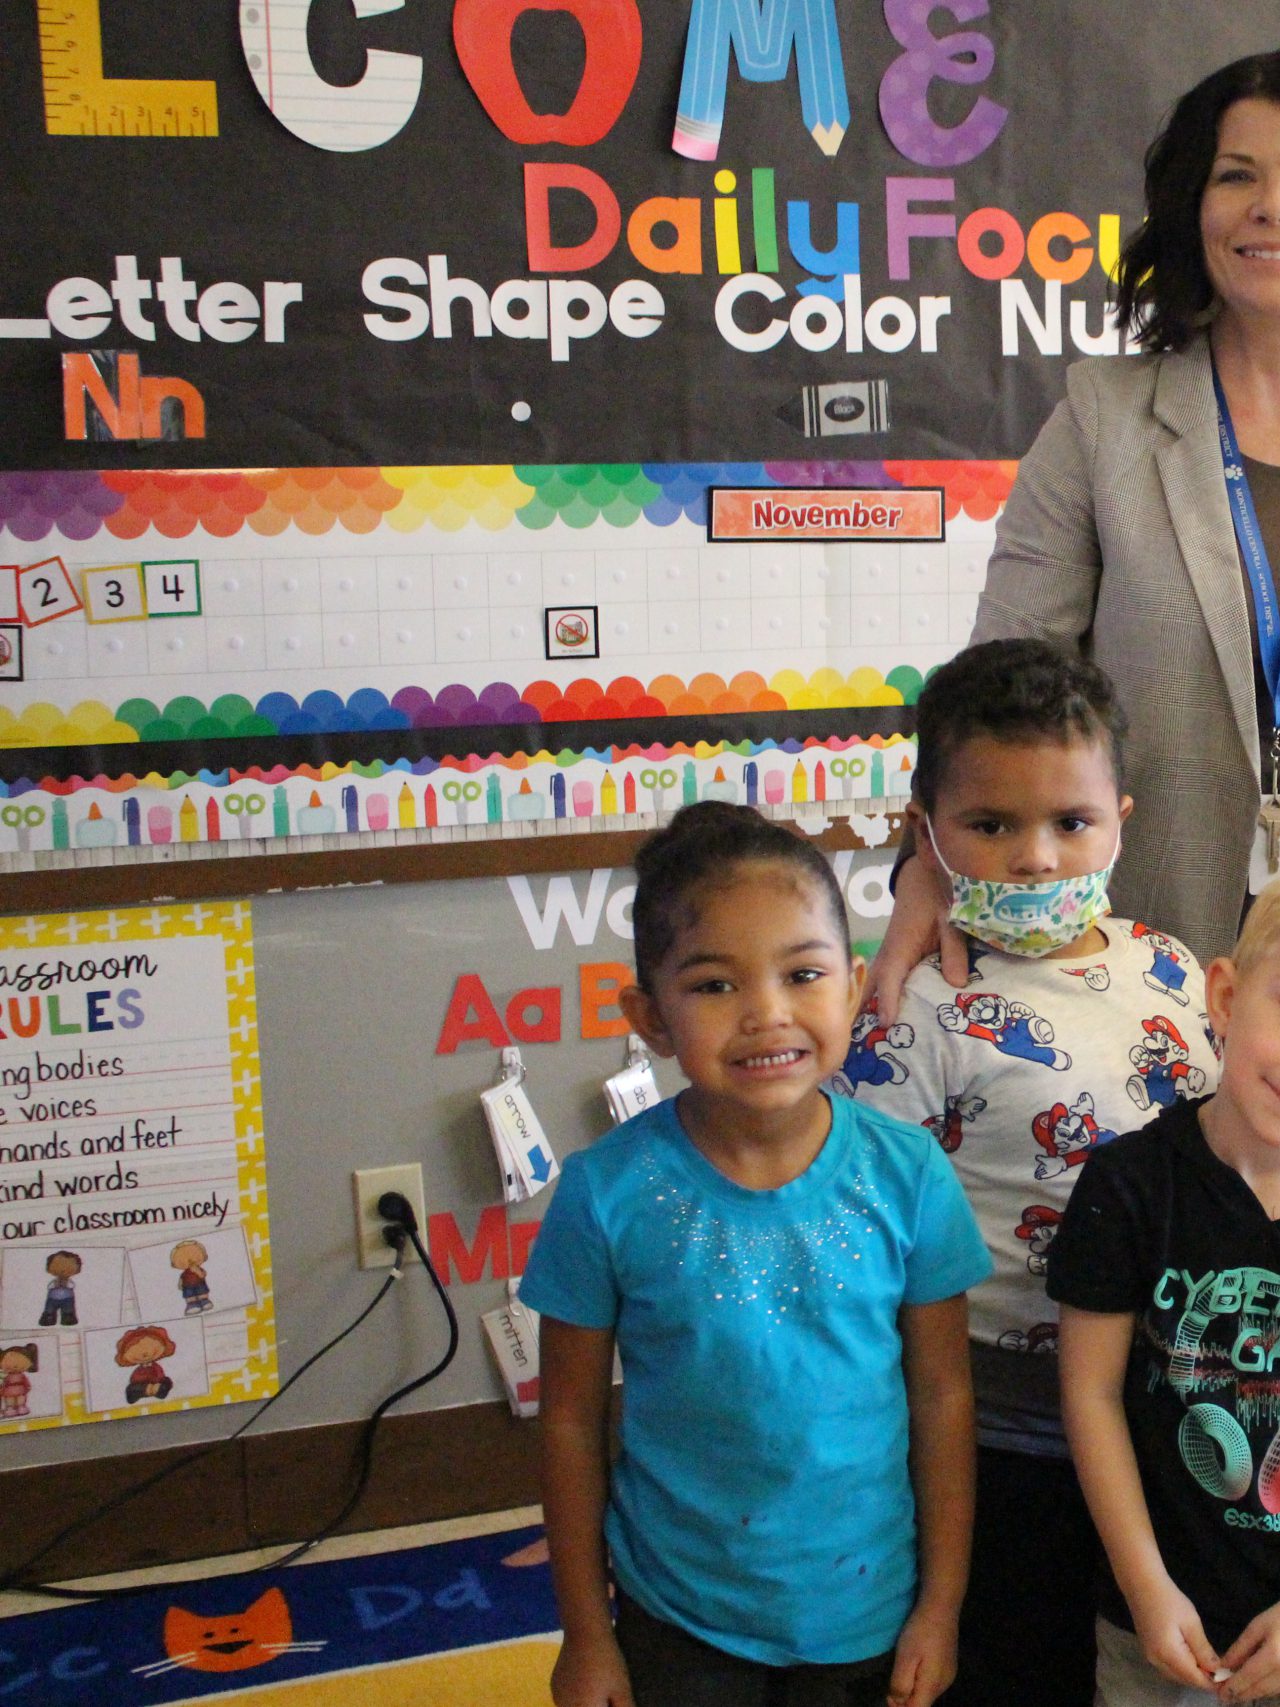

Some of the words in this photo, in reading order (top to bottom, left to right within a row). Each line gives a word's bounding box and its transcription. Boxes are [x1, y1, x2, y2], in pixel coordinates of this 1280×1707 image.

[524, 163, 860, 303] Daily
[886, 177, 1154, 285] Focu
[361, 254, 665, 361] Shape
[714, 272, 951, 353] Color
[1001, 279, 1142, 357] Nu
[62, 352, 206, 441] Nn
[753, 500, 902, 529] November
[32, 578, 59, 607] 2
[105, 580, 125, 608] 3
[162, 574, 184, 602] 4
[435, 973, 561, 1056] Aa
[579, 962, 638, 1040] B
[35, 1048, 124, 1082] bodies
[20, 1098, 97, 1122] voices
[503, 1094, 531, 1139] arrow
[81, 1126, 125, 1156] and
[131, 1116, 182, 1150] feet
[0, 1170, 44, 1203] ind
[54, 1160, 139, 1197] words
[3, 1220, 46, 1241] our
[54, 1203, 166, 1235] classroom
[173, 1191, 229, 1228] nicely
[499, 1313, 528, 1368] mitten
